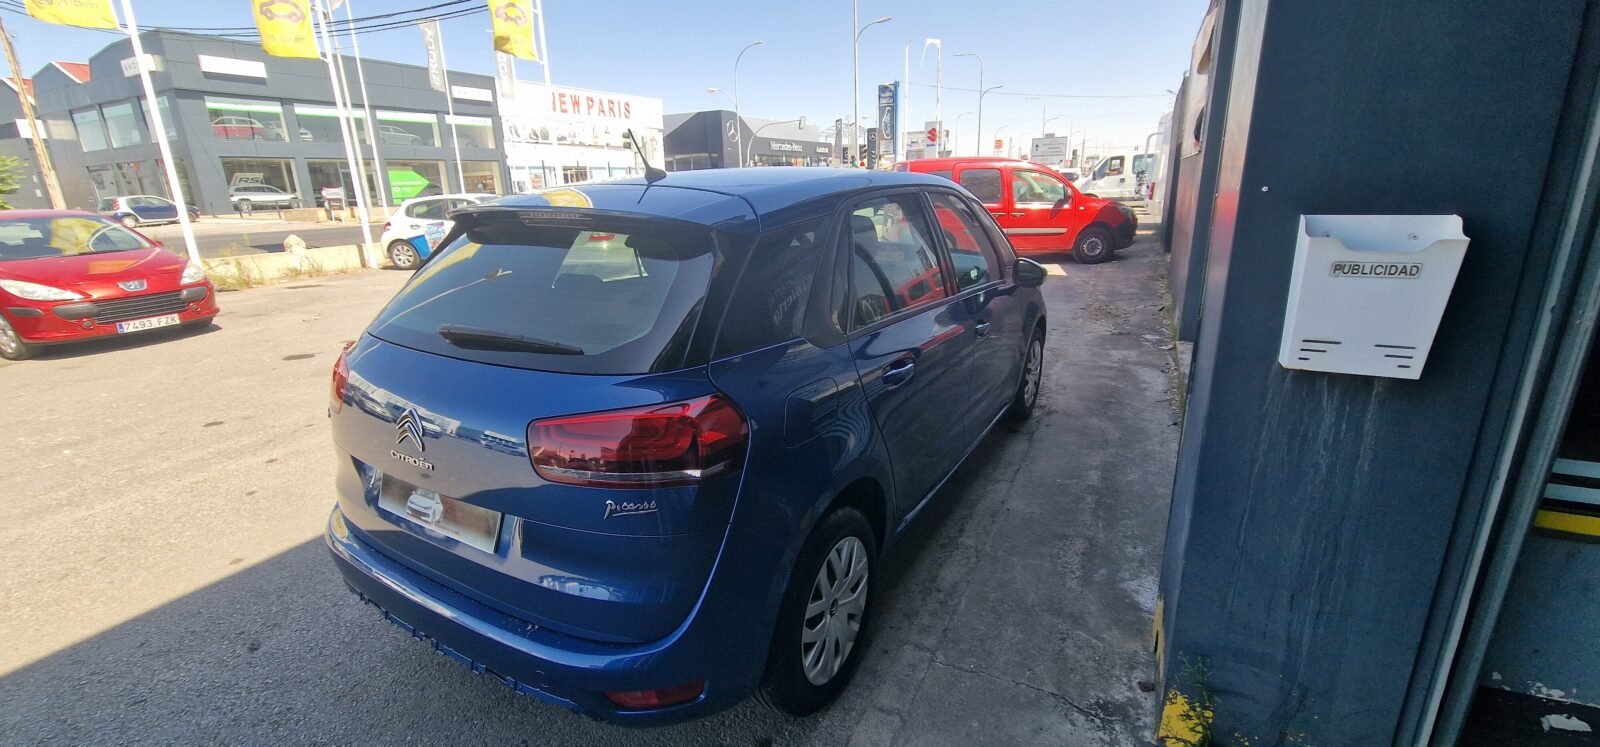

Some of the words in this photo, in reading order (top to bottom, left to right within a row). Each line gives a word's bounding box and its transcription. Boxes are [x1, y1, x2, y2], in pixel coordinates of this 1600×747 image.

[586, 96, 631, 119] PARIS
[238, 176, 261, 184] RS
[1332, 263, 1420, 277] PUBLICIDAD
[124, 319, 153, 332] 7493
[157, 316, 178, 327] FZK
[603, 499, 658, 520] Picasso
